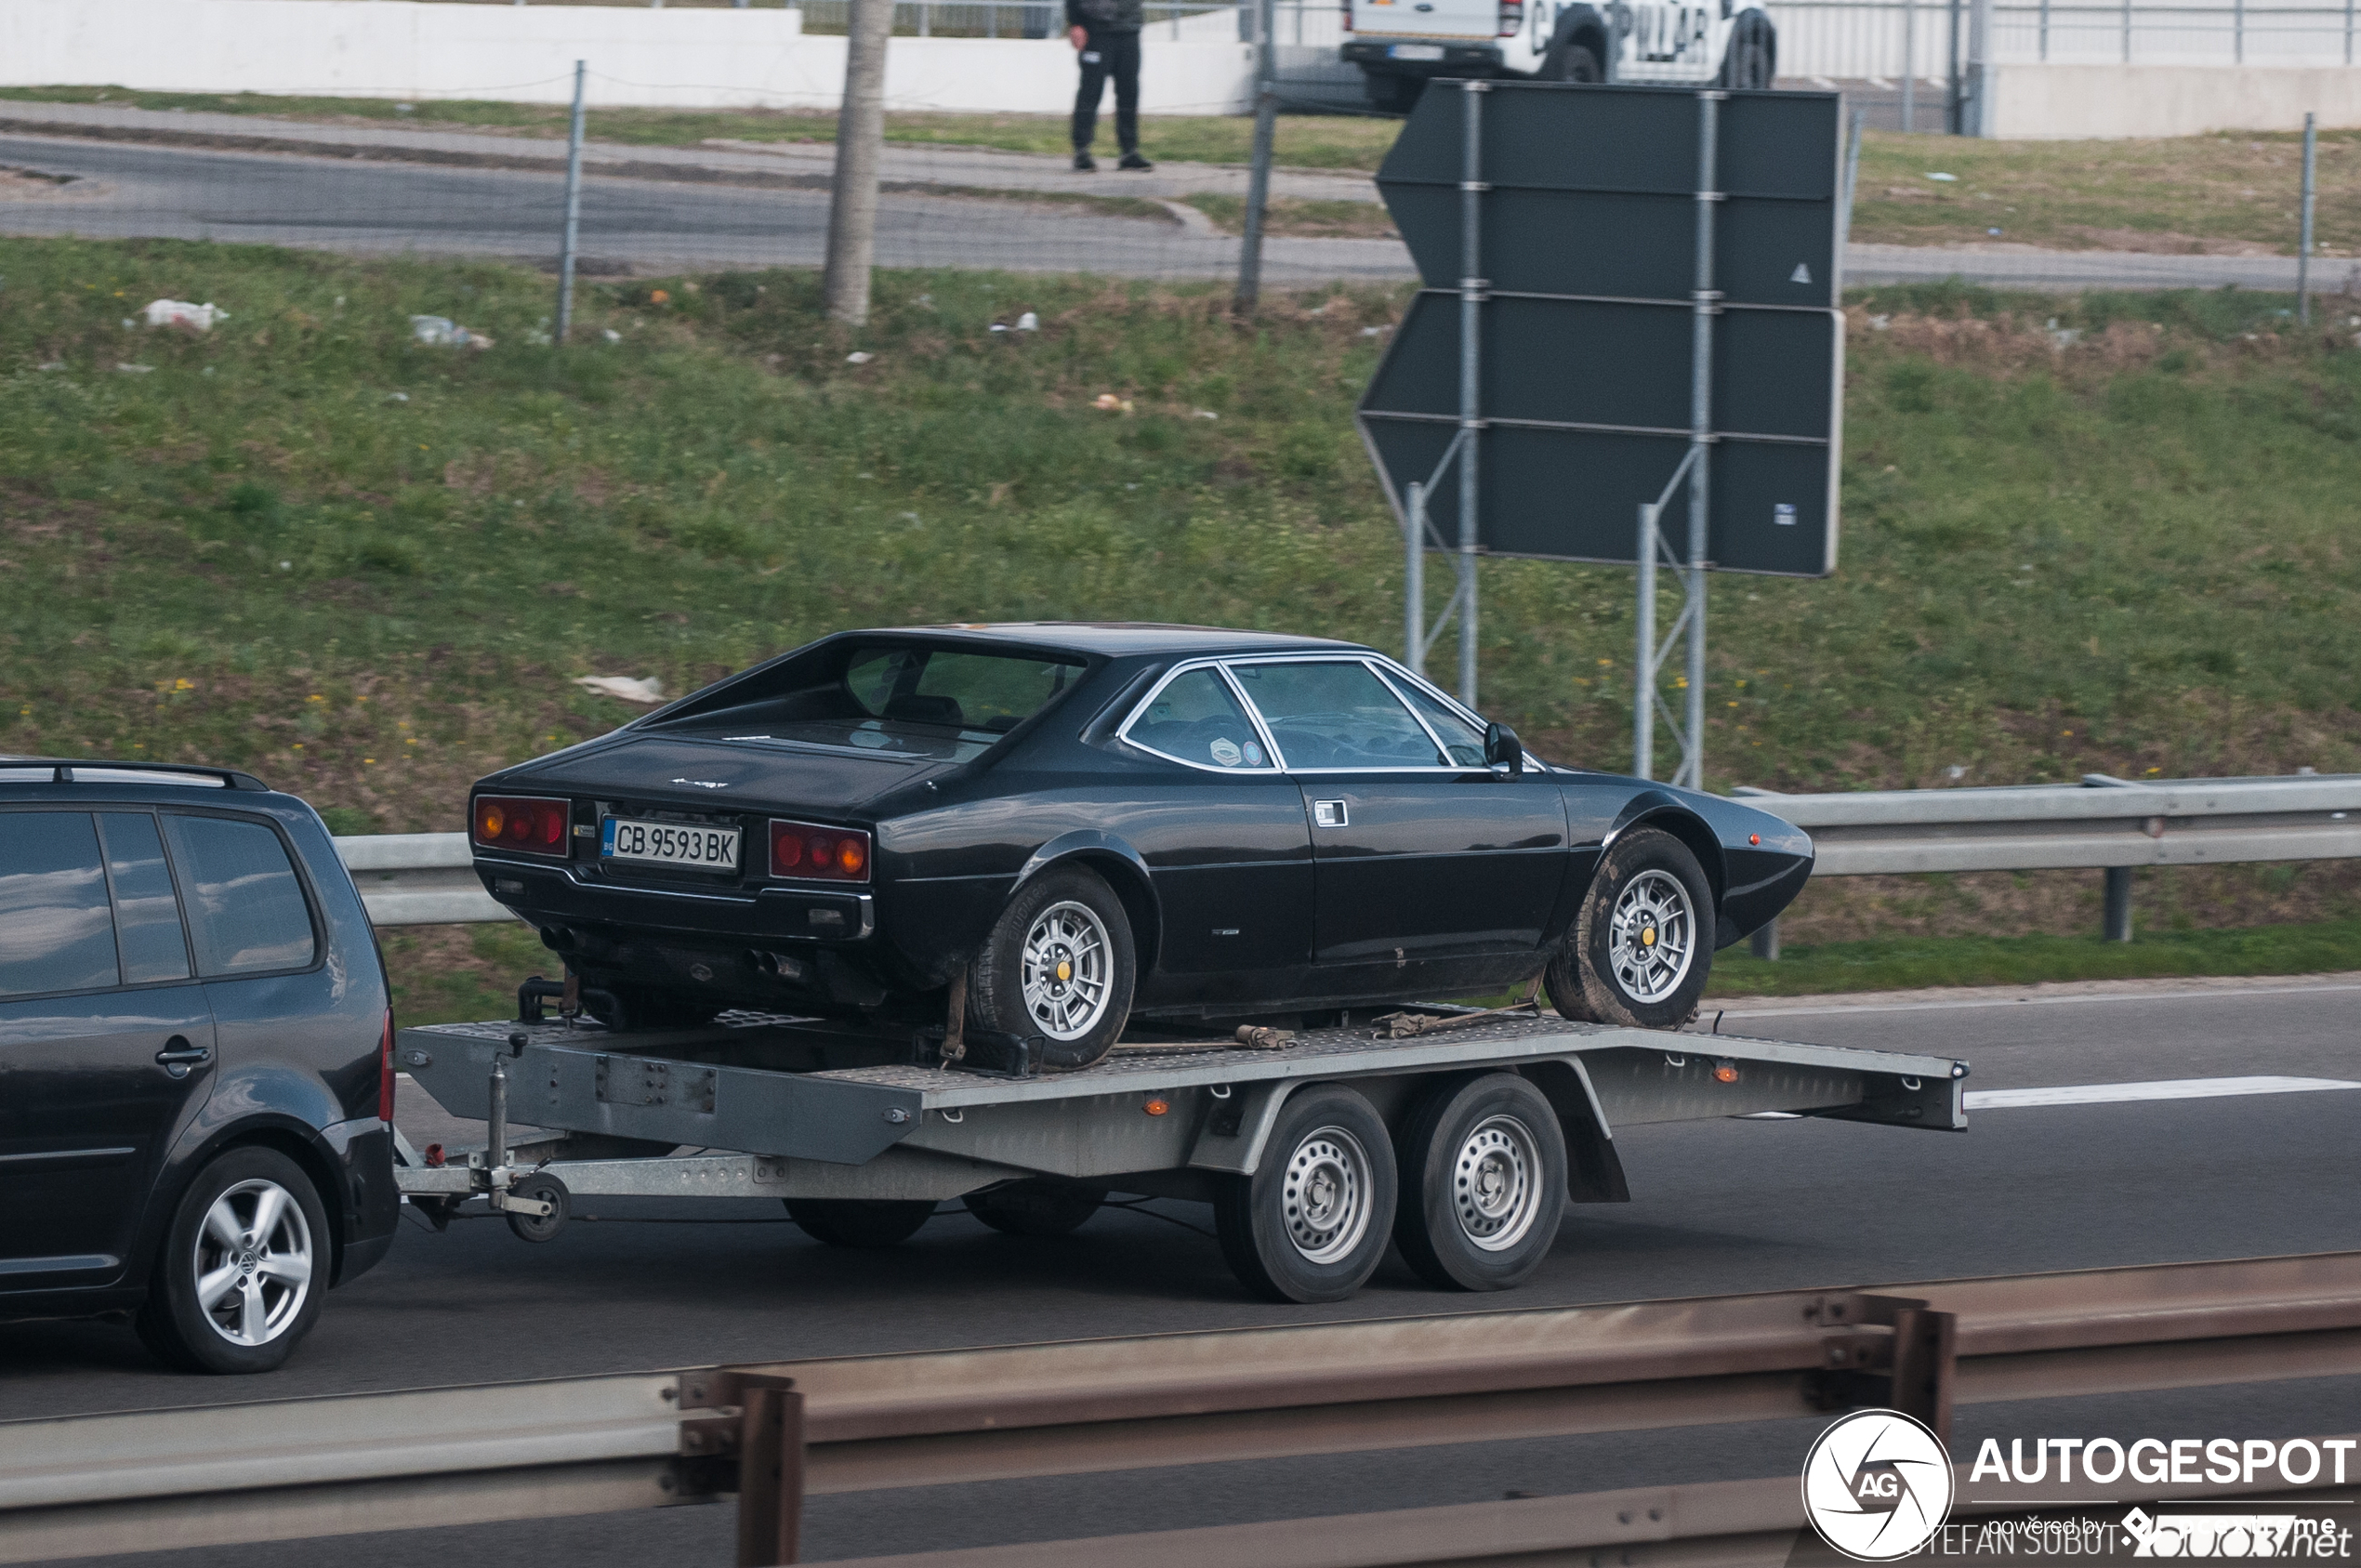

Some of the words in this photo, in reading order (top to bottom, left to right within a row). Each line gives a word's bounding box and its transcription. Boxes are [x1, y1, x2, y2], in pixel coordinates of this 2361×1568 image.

[617, 825, 645, 854] CB
[651, 828, 702, 860] 9593
[706, 833, 734, 863] BK
